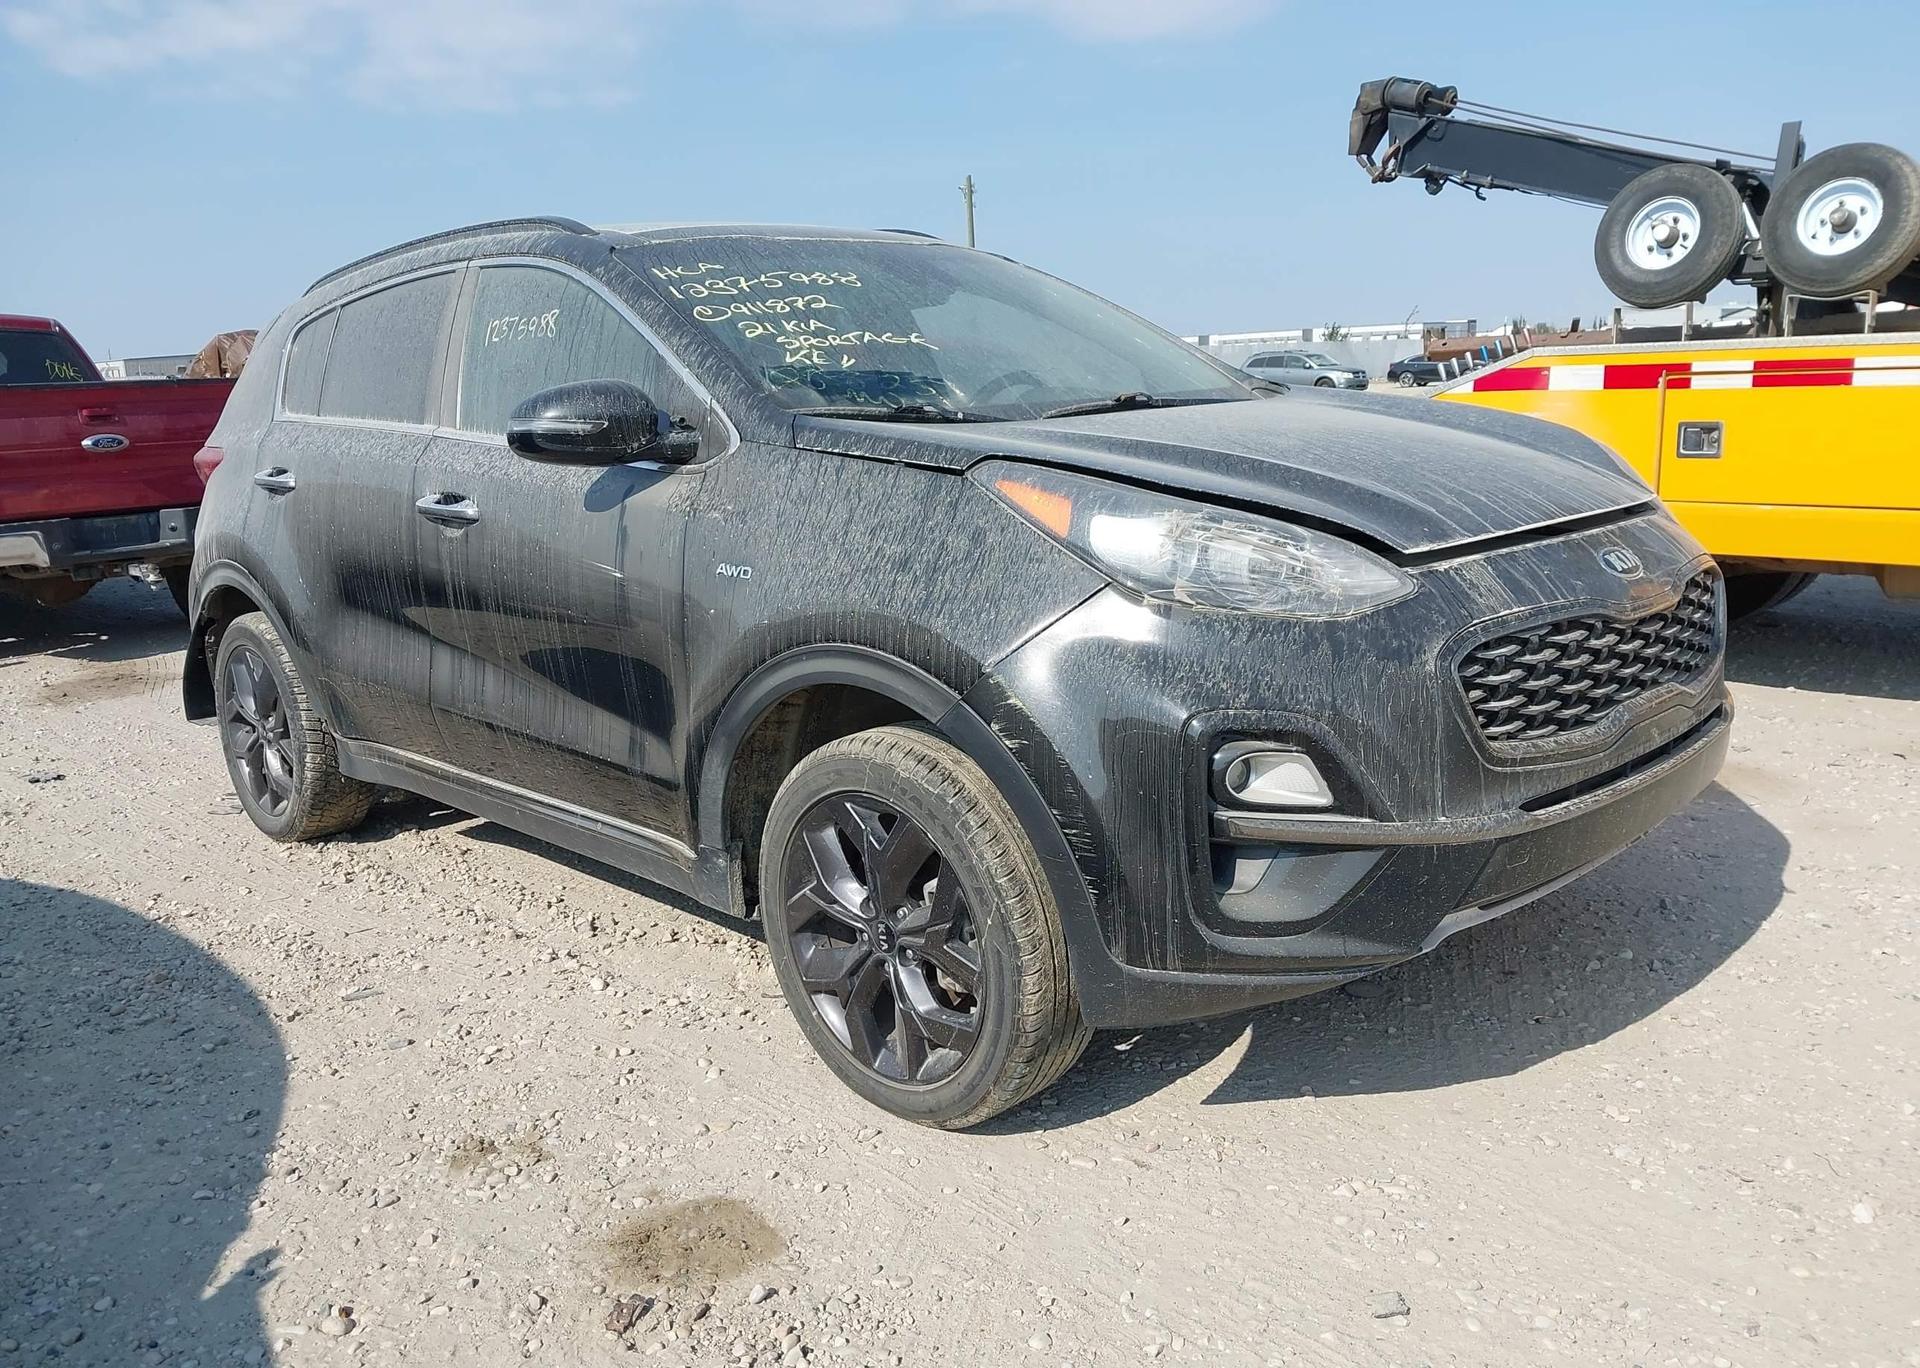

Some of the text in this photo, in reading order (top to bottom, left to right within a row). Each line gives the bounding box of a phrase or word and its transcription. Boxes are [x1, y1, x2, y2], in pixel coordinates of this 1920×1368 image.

[485, 309, 560, 347] 12375988
[738, 319, 836, 338] 21 KIA
[98, 438, 119, 448] Ford
[715, 562, 752, 582] AWD
[878, 923, 889, 951] KIA
